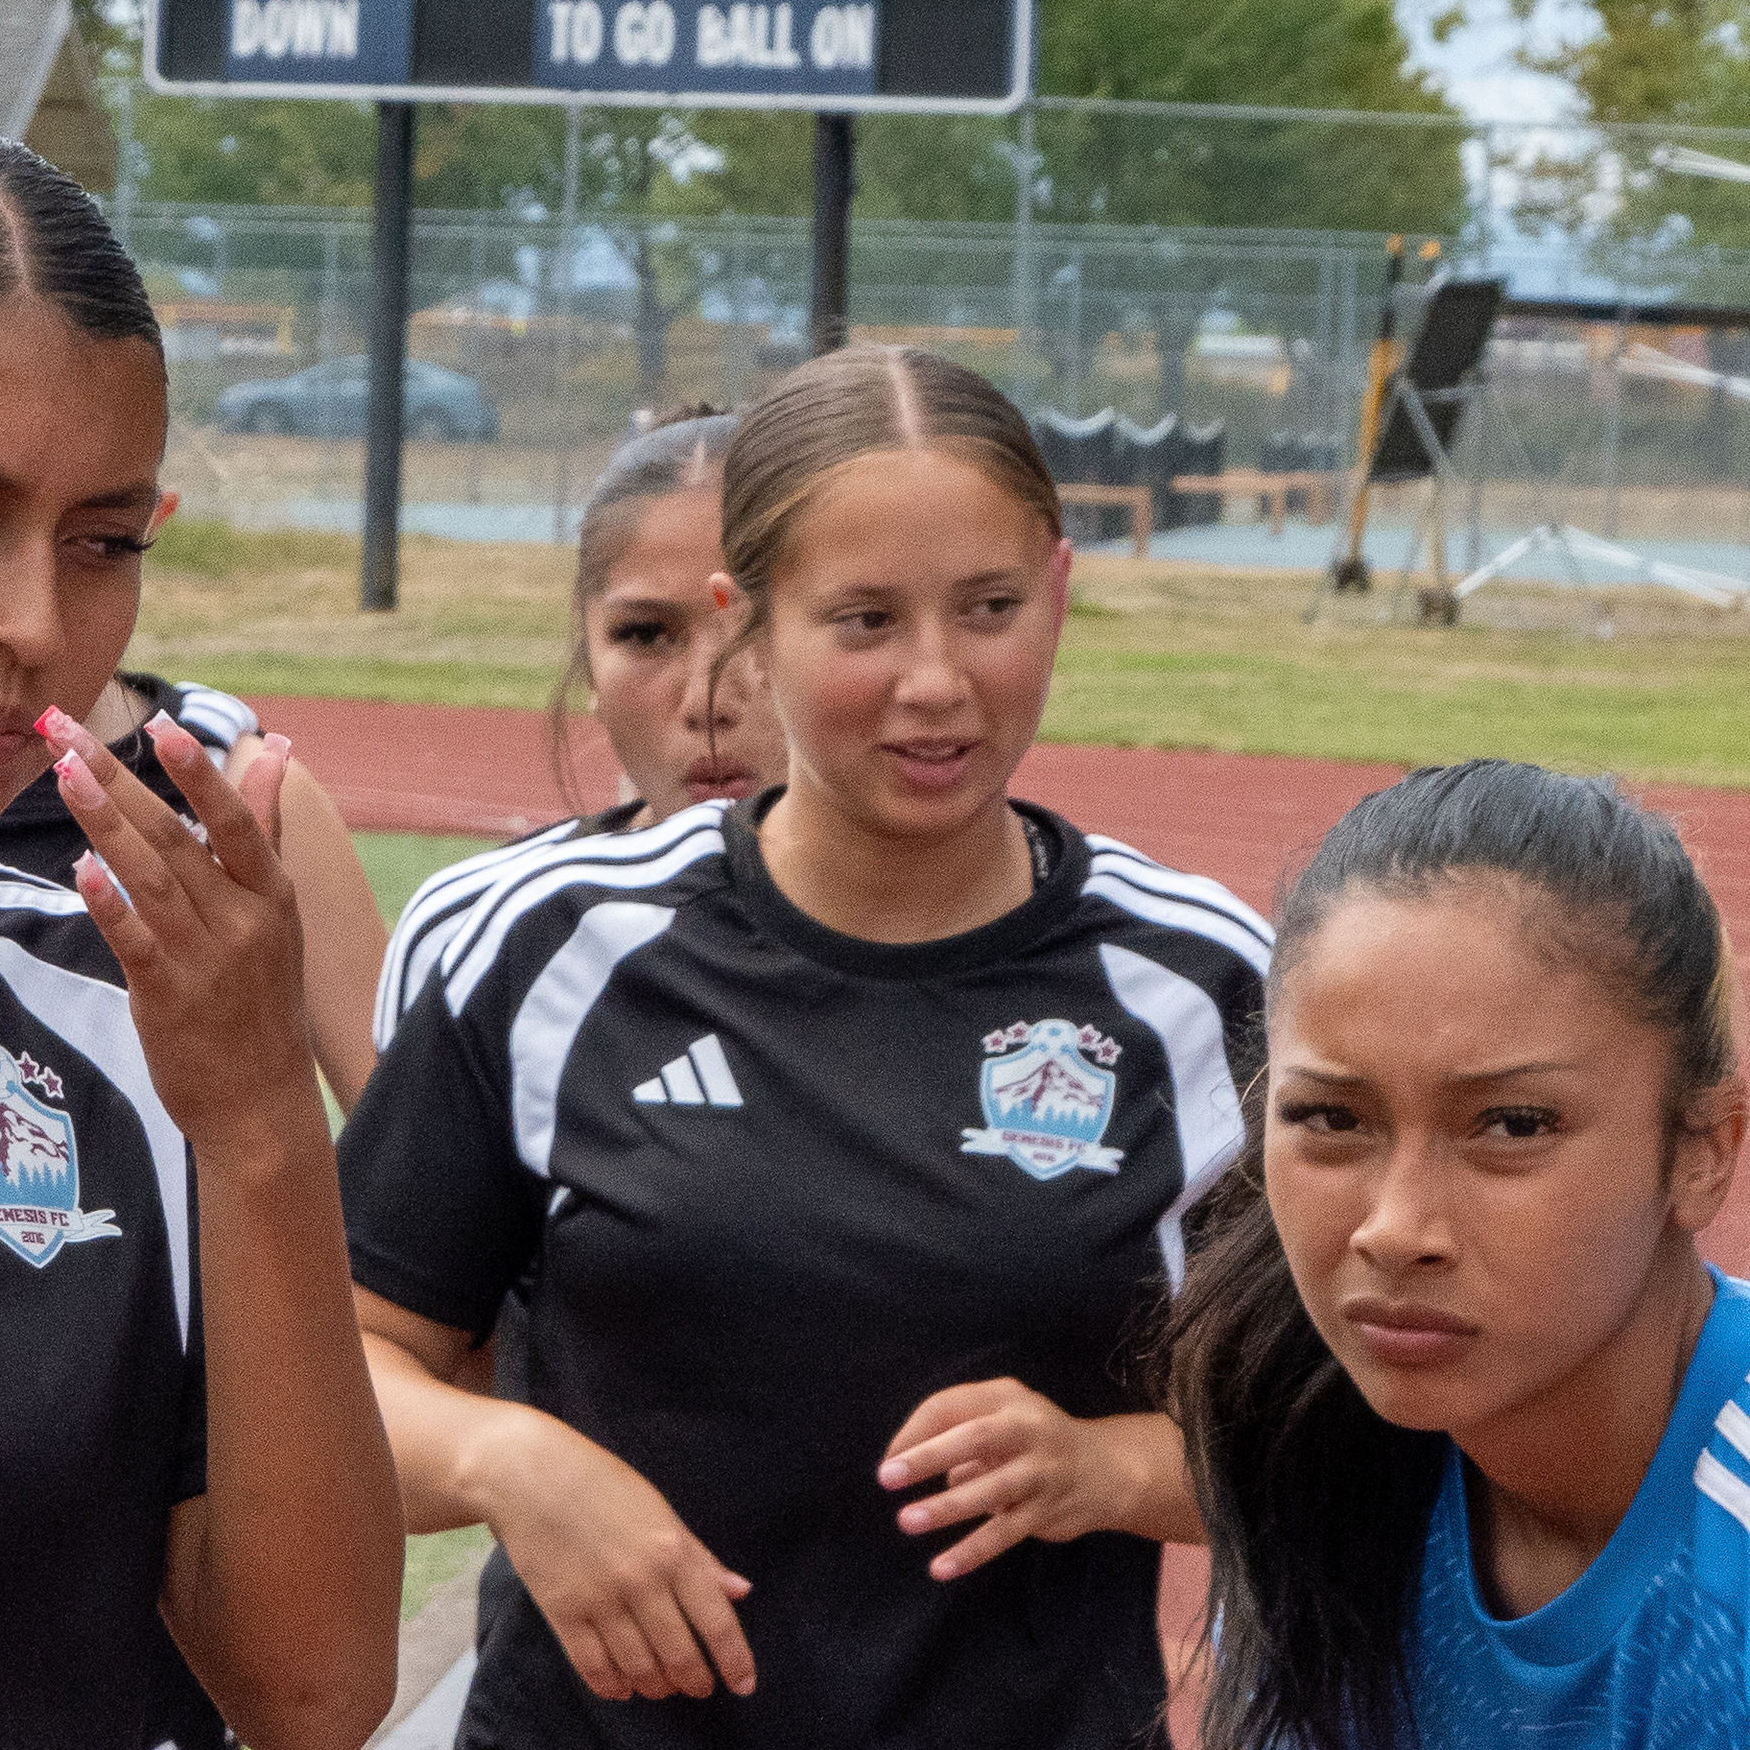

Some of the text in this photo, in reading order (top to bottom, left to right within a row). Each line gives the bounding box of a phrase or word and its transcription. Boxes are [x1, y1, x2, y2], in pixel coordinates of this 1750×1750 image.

[613, 0, 676, 66] GO
[696, 2, 874, 70] BALL ON
[21, 1230, 46, 1245] 2016
[50, 1211, 70, 1227] FC
